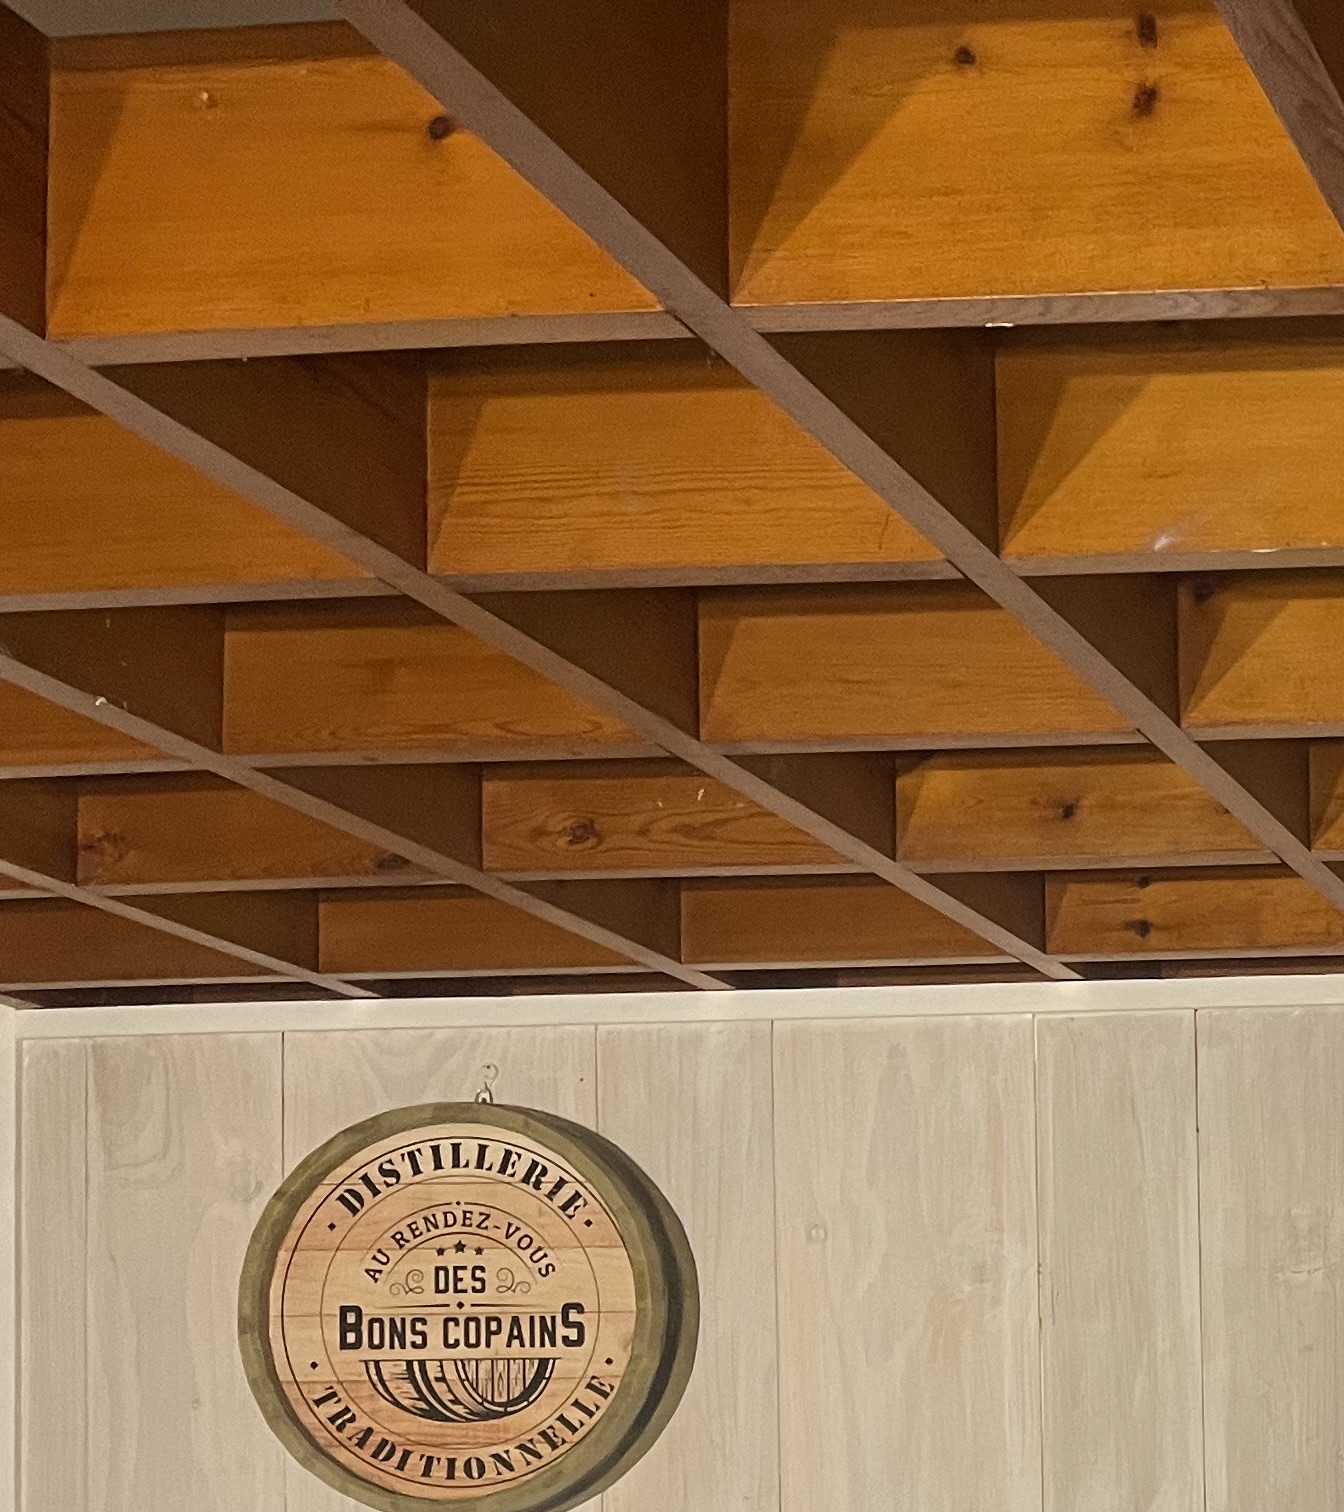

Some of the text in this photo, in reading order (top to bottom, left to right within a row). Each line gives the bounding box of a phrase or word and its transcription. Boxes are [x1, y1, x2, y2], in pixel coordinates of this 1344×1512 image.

[335, 1142, 590, 1219] DISTILLERIE
[365, 1209, 556, 1283] AU RENDEZ-VOUS
[434, 1265, 485, 1294] DES
[339, 1302, 585, 1351] BONS COPAINS
[312, 1375, 615, 1481] TRADITIONNELLE
